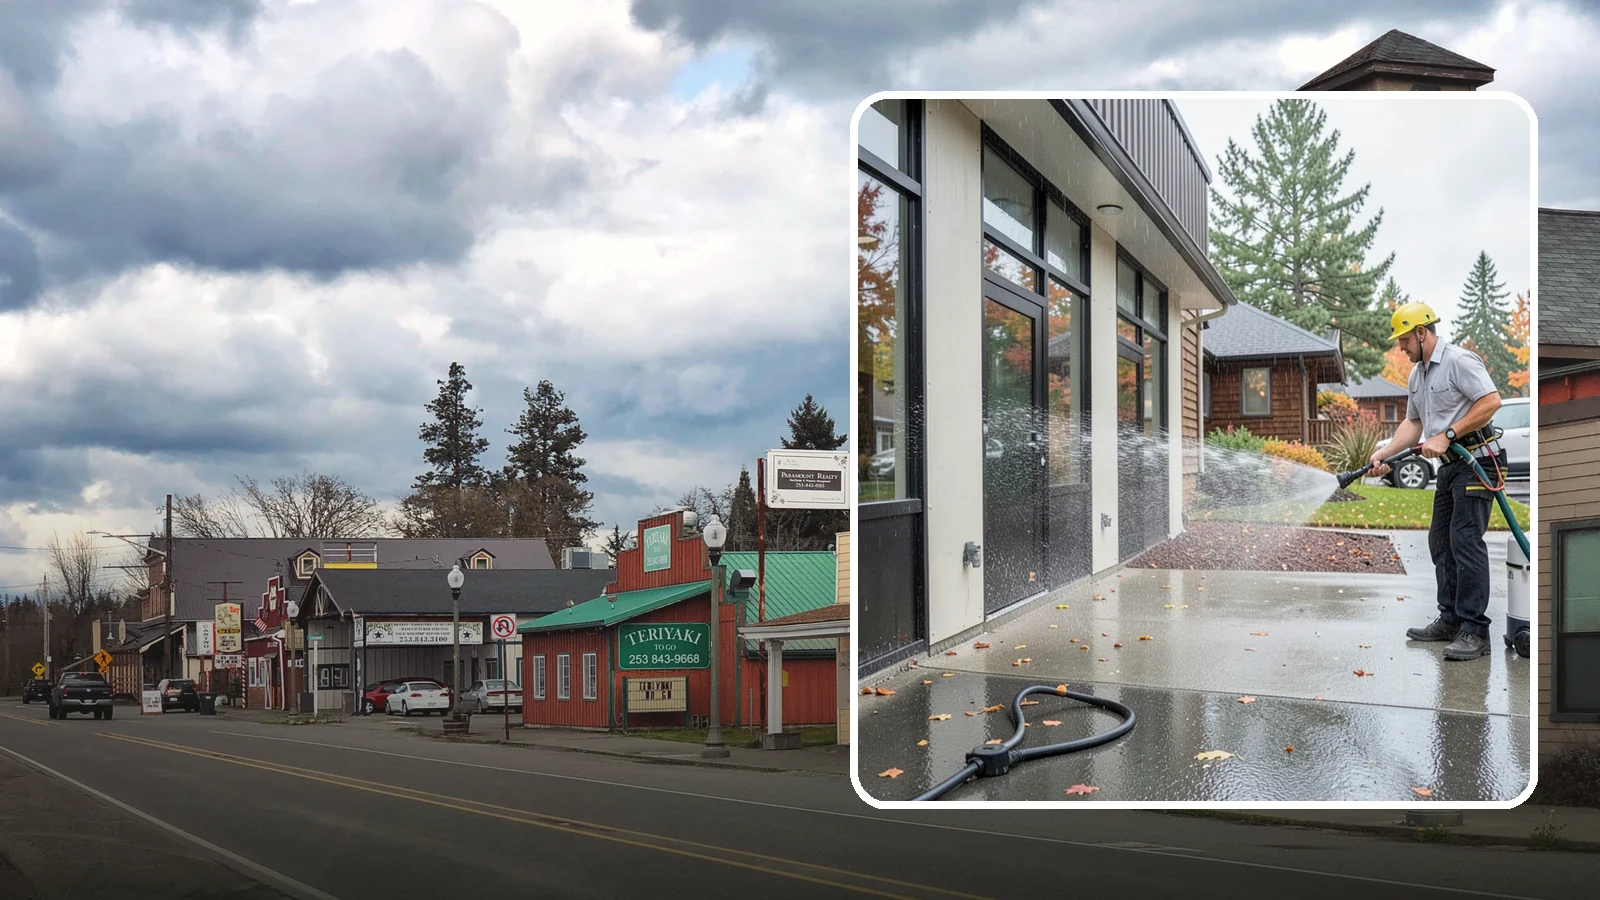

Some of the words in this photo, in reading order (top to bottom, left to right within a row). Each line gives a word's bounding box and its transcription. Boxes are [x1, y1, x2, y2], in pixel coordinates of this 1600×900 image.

[624, 627, 702, 646] TERIYAKI
[665, 643, 677, 651] GO
[628, 654, 649, 664] 253
[651, 653, 700, 664] 843-9668
